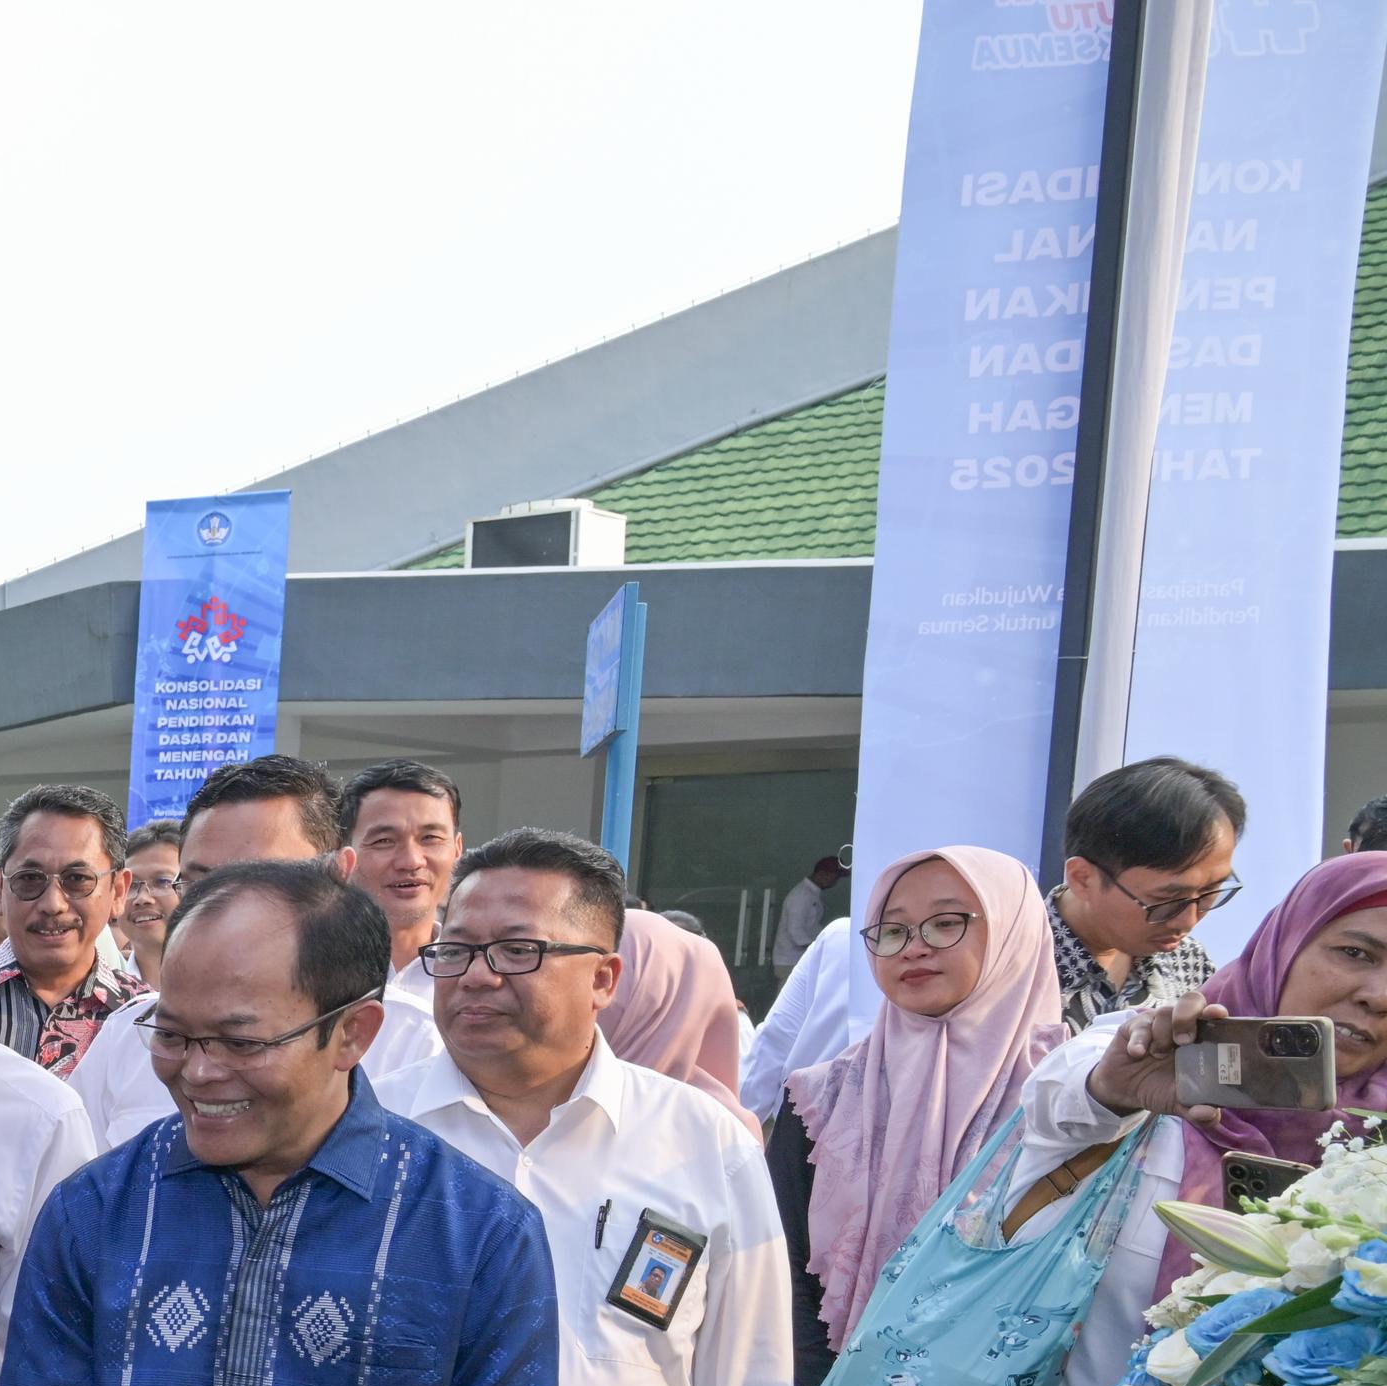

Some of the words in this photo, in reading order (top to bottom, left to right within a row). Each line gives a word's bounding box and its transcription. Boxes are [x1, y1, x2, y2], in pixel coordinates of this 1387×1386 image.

[155, 679, 261, 693] KONSOLIDASI
[166, 696, 247, 711] NASIONAL
[157, 714, 254, 728] PENDIDIKAN
[159, 733, 212, 745] DASAR
[217, 732, 250, 744] DAN
[159, 750, 248, 763] MENENGAH
[154, 768, 208, 781] TAHUN
